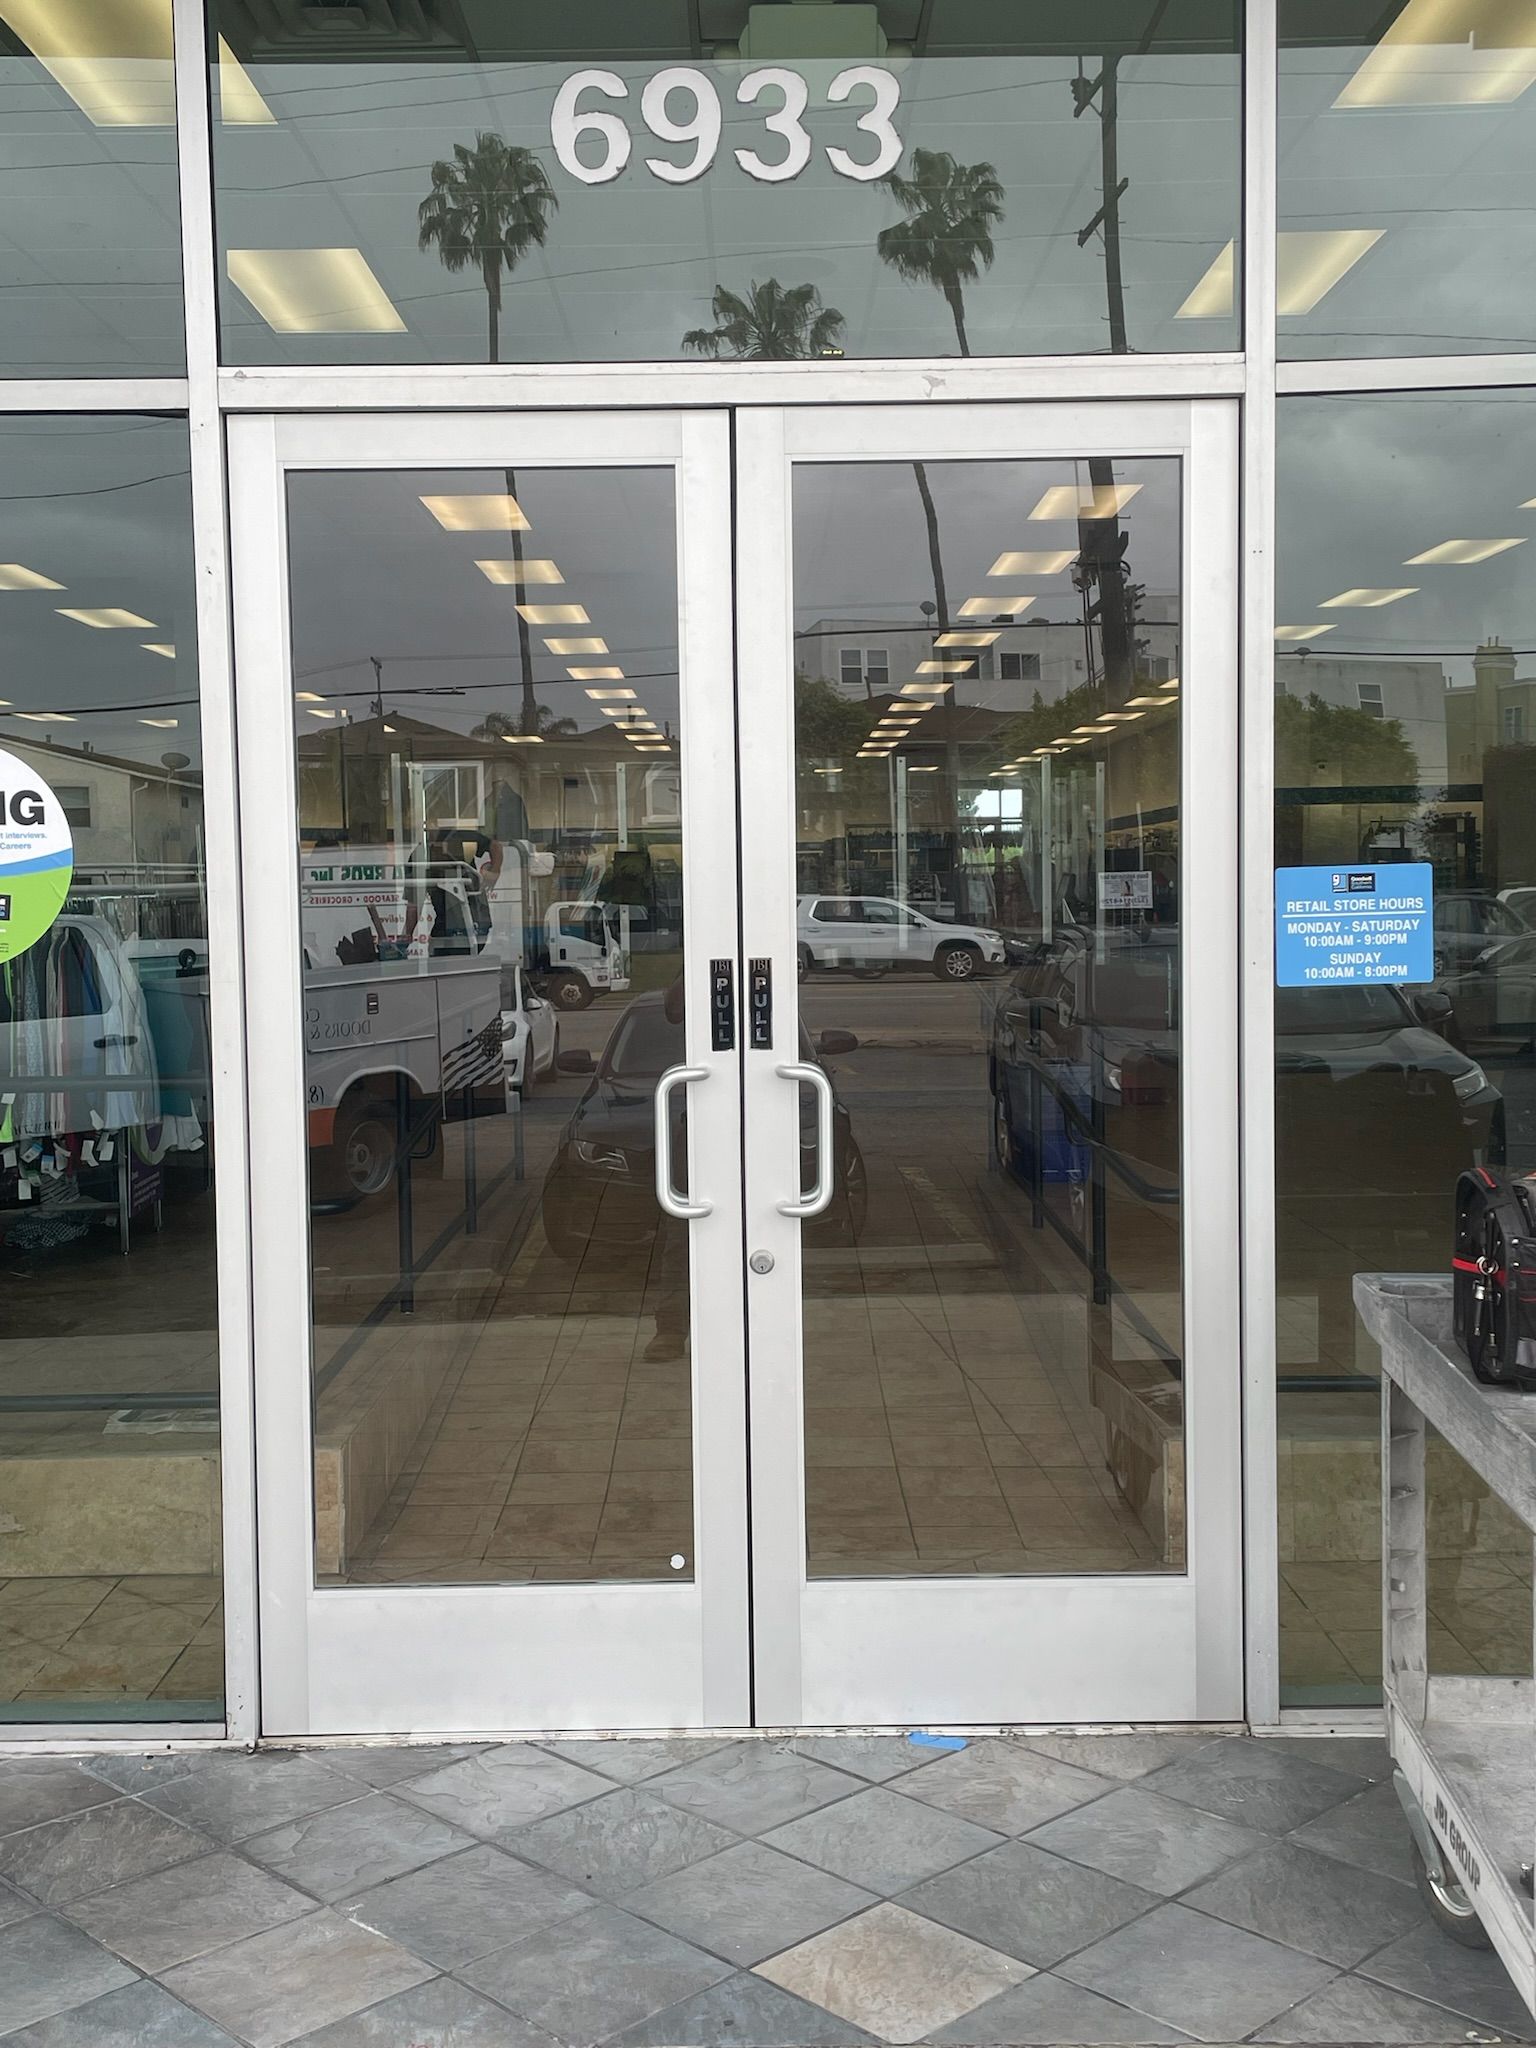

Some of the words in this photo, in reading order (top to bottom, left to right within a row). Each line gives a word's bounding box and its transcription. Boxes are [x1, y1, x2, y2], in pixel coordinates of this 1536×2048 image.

[550, 65, 904, 184] 6933
[0, 790, 45, 825] G
[5, 831, 47, 839] interviews.
[0, 842, 32, 850] Careers
[1287, 901, 1331, 913] RETAIL
[1334, 899, 1376, 911] STORE
[1379, 897, 1424, 909] HOURS
[1287, 921, 1341, 934] MONDAY
[1352, 919, 1420, 932] SATURDAY
[1304, 935, 1354, 947] 10:00AM
[1364, 933, 1407, 945] 9:00PM
[1330, 952, 1381, 965] SUNDAY
[1304, 967, 1354, 979] 10:00AM
[1365, 965, 1408, 977] 8:00PM
[716, 978, 730, 1042] PULL
[755, 977, 768, 1041] PULL
[1434, 1793, 1447, 1836] JBI
[1450, 1819, 1480, 1892] GROUP
